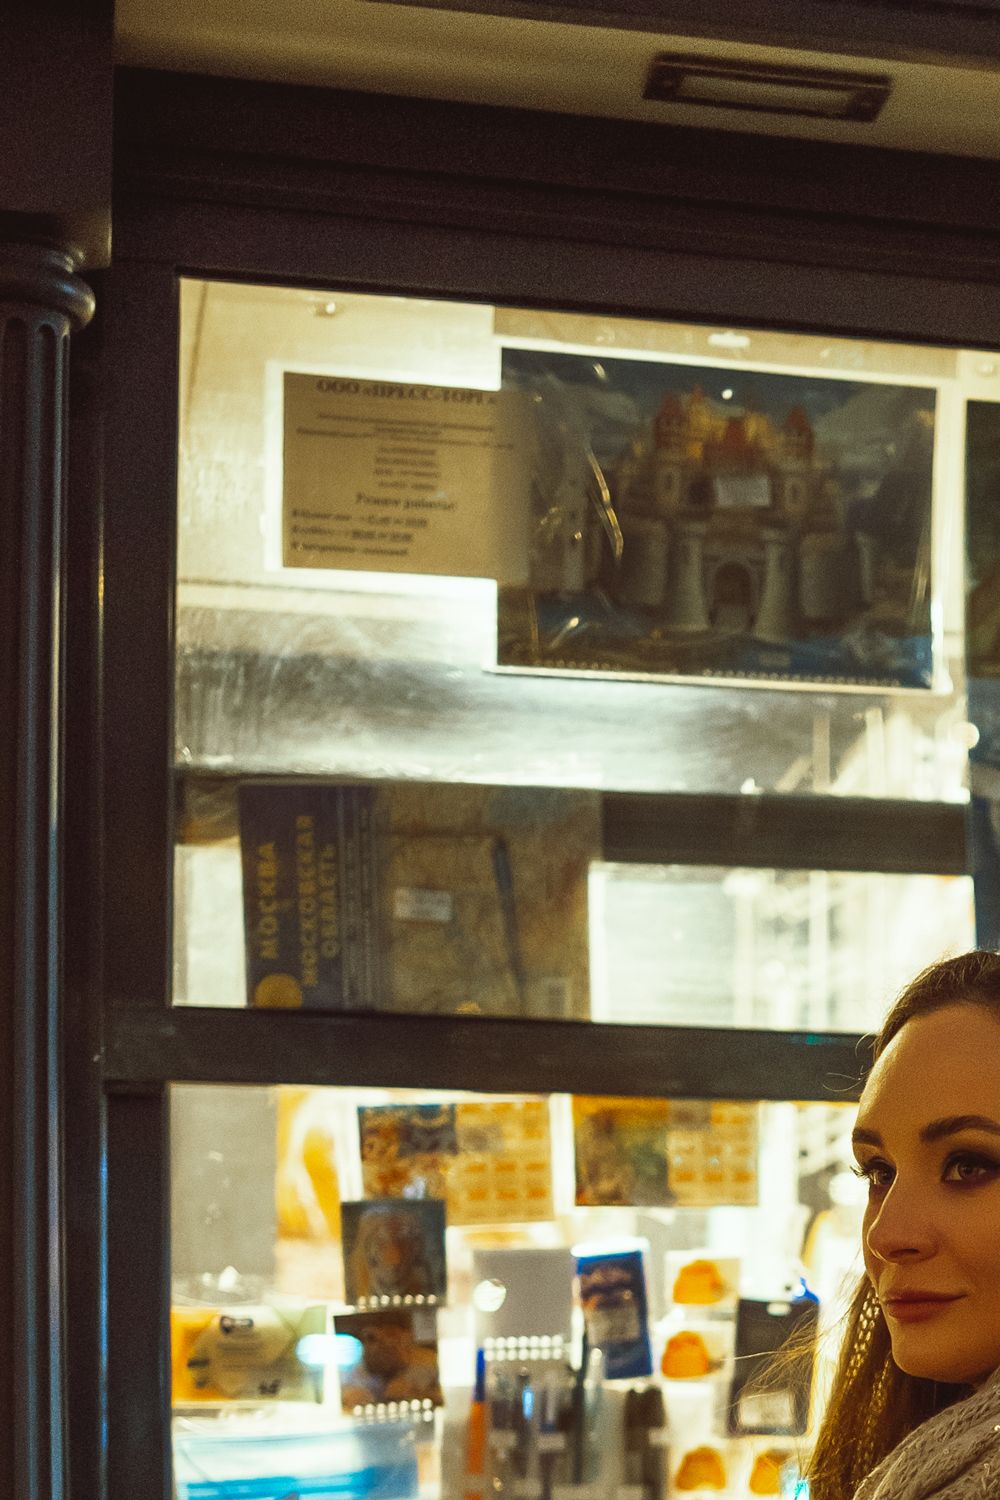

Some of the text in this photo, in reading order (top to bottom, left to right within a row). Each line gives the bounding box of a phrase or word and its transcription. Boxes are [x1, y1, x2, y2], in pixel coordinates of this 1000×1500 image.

[257, 841, 279, 958] МОСКВА
[295, 815, 319, 988] МОСКОВСКАЯ
[318, 843, 340, 959] ОБЛАСТЬ
